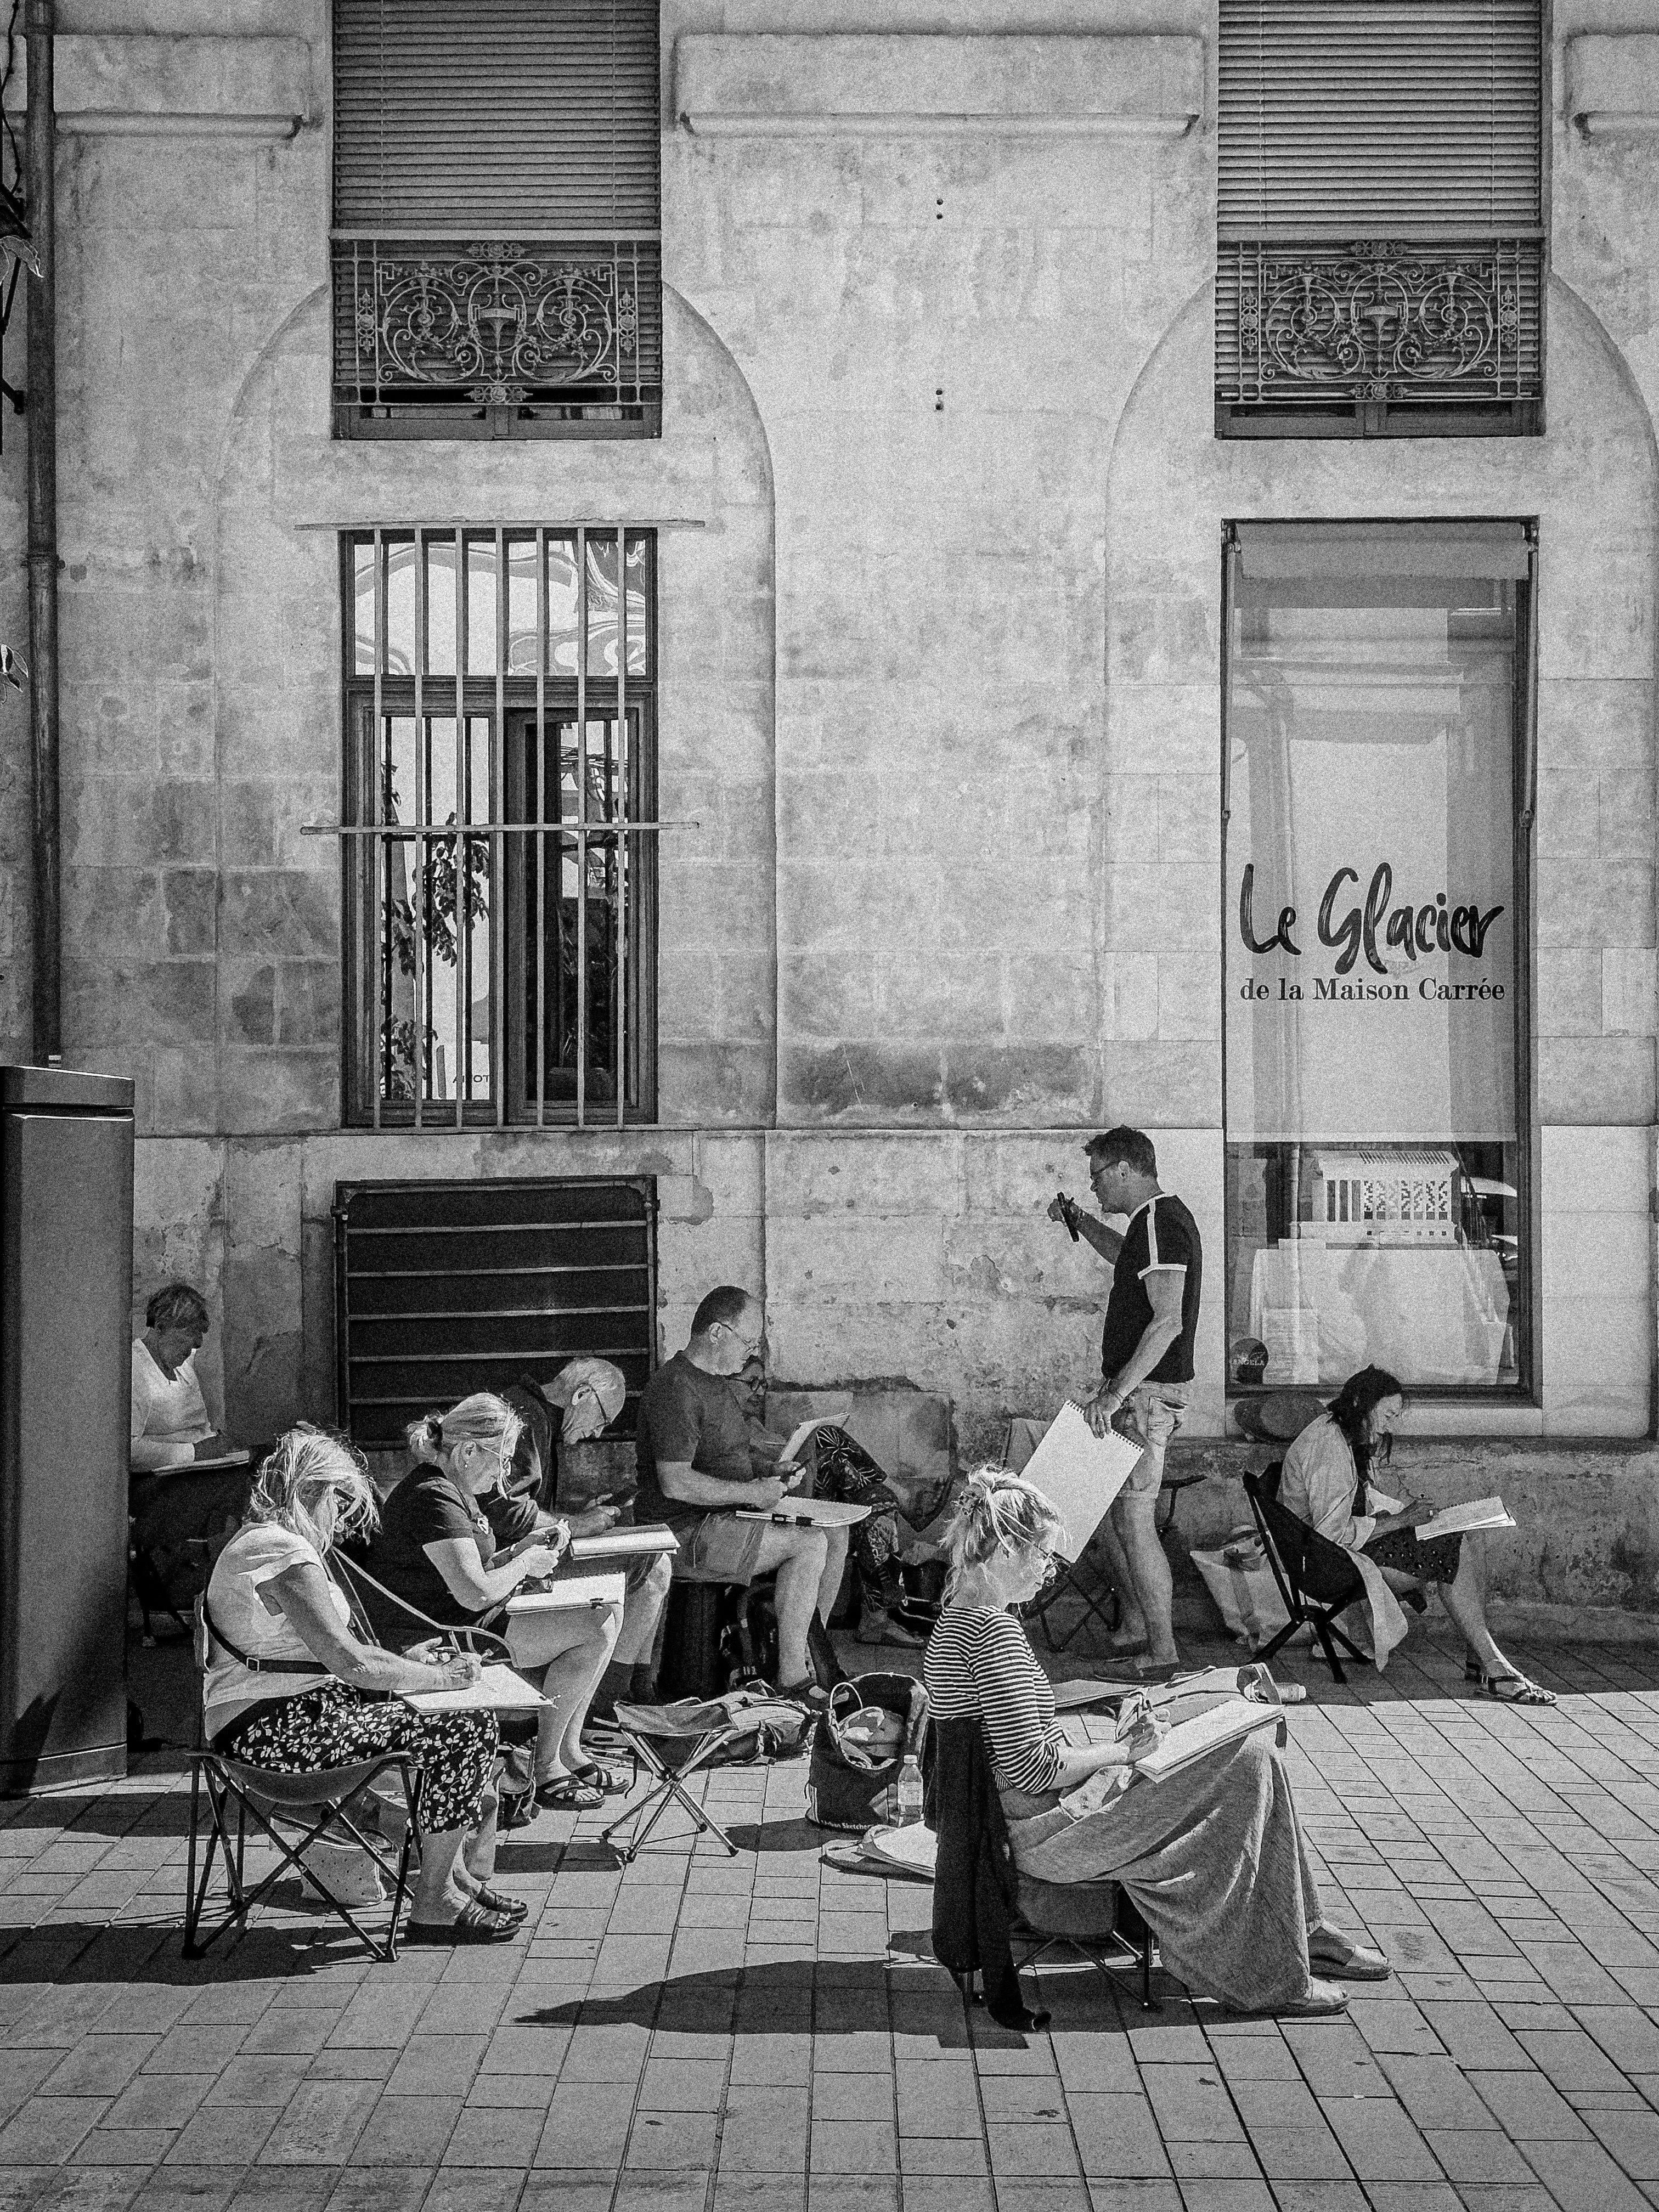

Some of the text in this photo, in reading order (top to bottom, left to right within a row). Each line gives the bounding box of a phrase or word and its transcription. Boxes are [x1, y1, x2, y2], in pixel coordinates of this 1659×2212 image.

[1239, 862, 1505, 974] Le Glacier
[1240, 977, 1505, 1000] de la Maison Carrée
